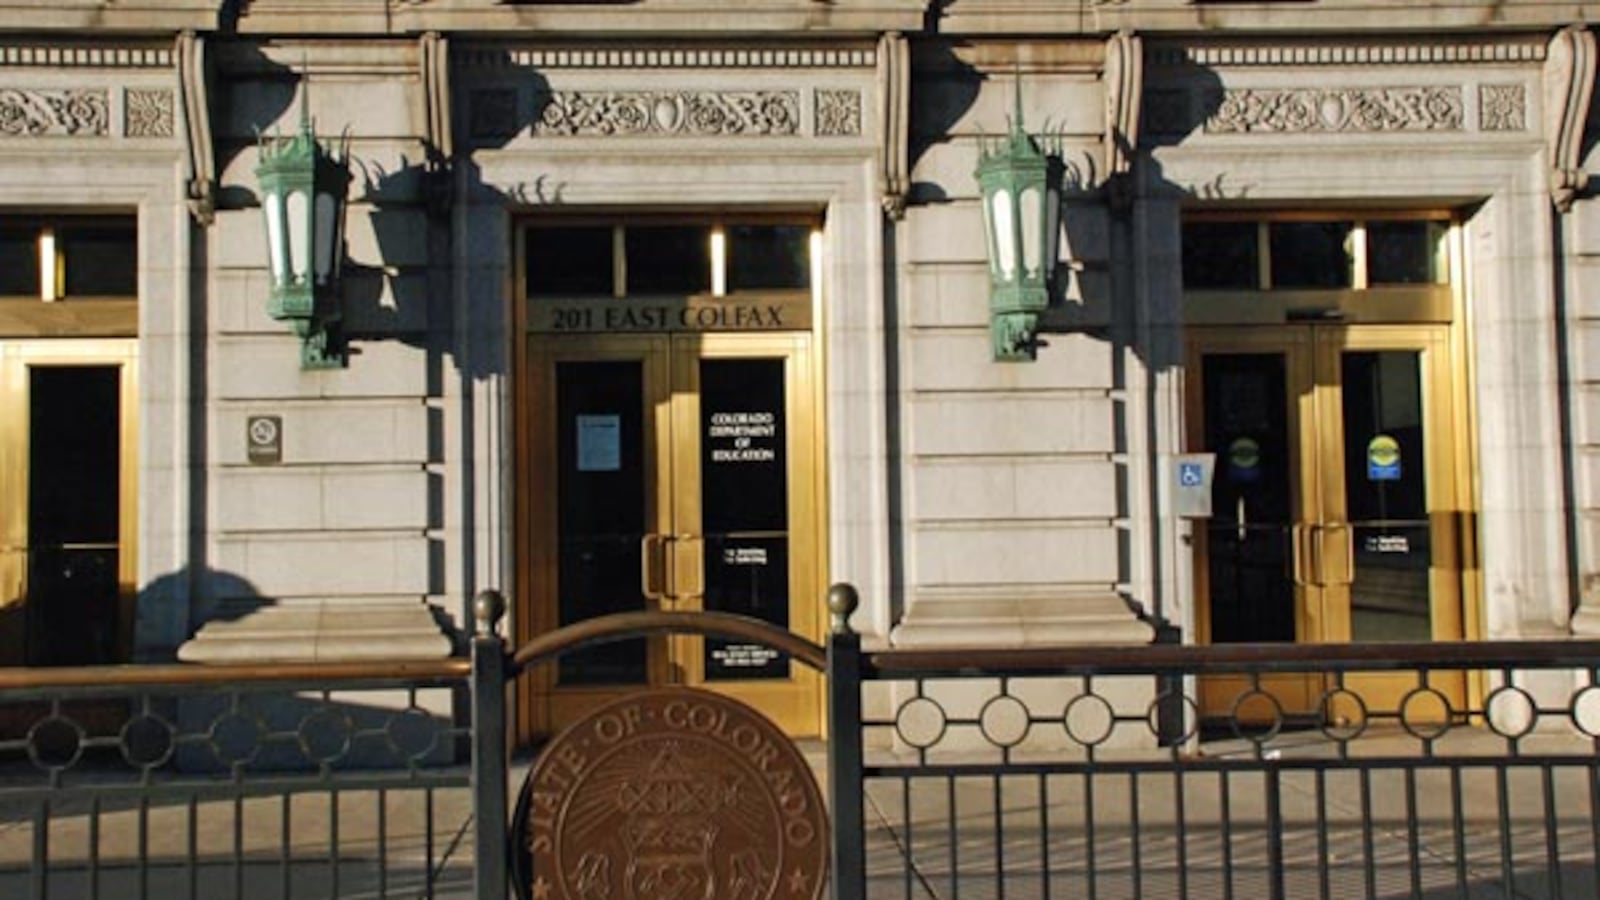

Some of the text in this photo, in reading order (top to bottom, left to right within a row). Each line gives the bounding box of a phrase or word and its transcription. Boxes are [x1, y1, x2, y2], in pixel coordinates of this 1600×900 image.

[552, 305, 783, 329] 201 EAST COLFAX
[710, 412, 775, 425] COLORADO
[709, 424, 775, 437] DEPARTMENT
[734, 437, 751, 449] OF
[712, 448, 775, 461] EDUCATION
[530, 701, 814, 852] STATE OF COLORADO
